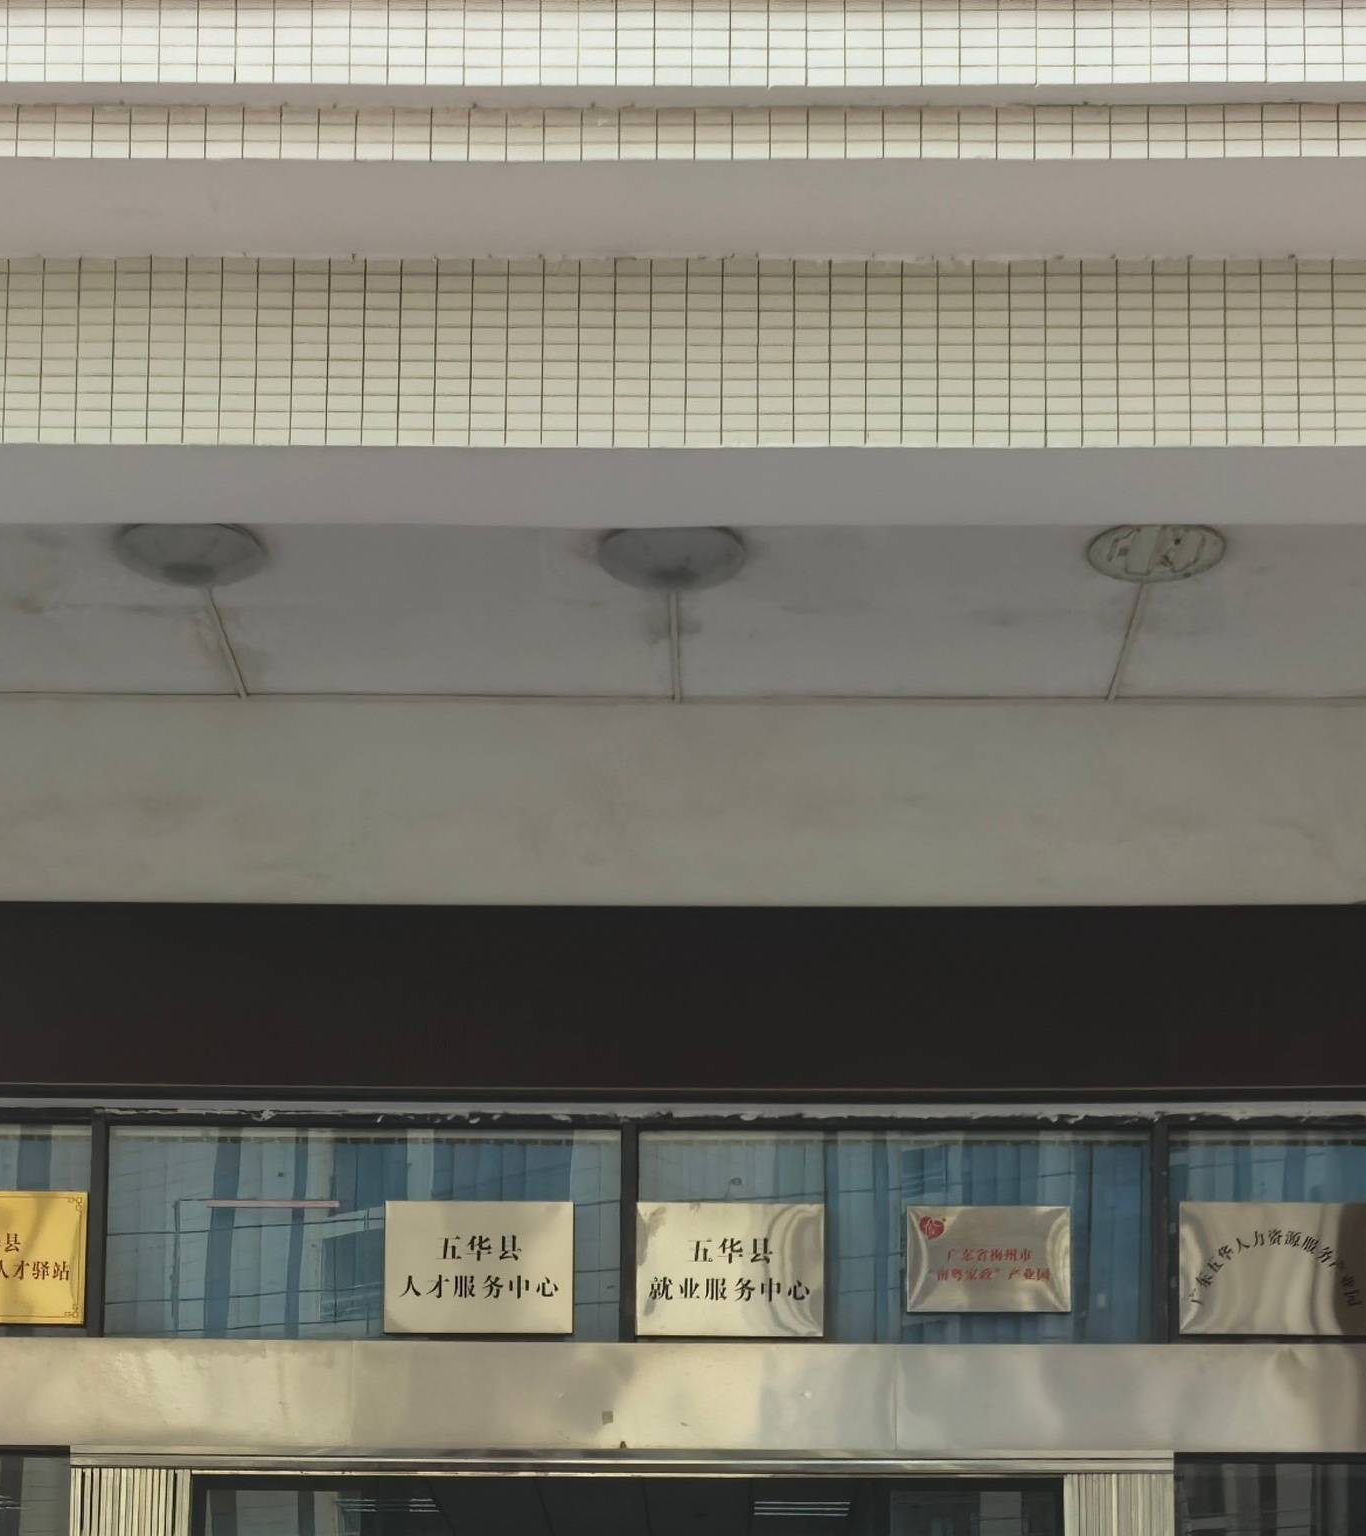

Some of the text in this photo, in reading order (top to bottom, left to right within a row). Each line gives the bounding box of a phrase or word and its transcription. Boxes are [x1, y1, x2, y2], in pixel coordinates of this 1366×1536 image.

[436, 1234, 523, 1261] 五华县
[688, 1237, 774, 1264] 五华县
[398, 1275, 559, 1300] 人才服务中心
[648, 1276, 811, 1302] 就业服务中心
